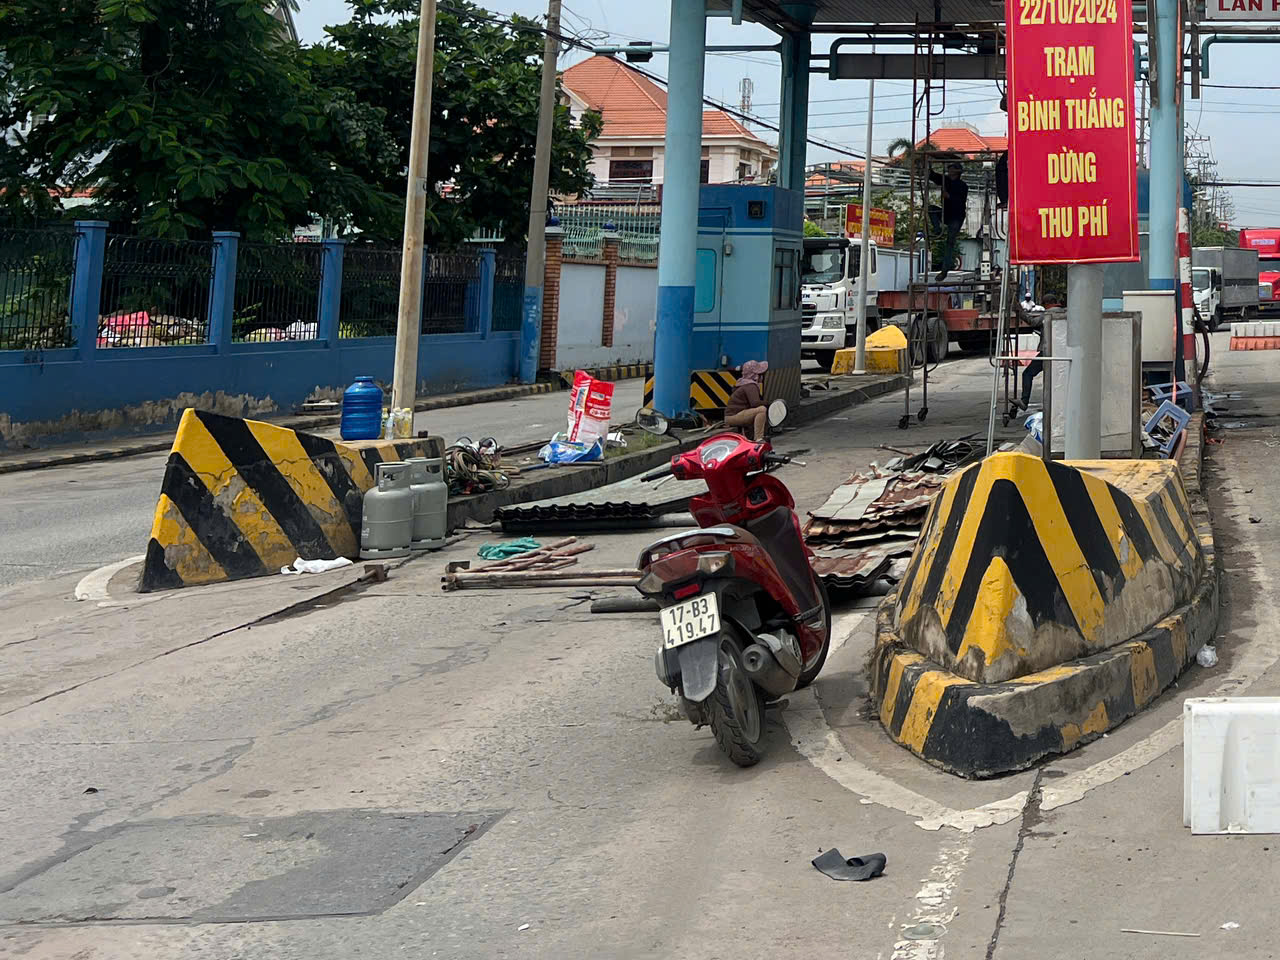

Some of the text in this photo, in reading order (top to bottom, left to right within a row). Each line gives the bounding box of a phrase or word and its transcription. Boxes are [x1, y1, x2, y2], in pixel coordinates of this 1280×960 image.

[1044, 46, 1095, 83] TRẠM
[1017, 87, 1124, 132] BÌNH THẮNG
[1047, 146, 1097, 184] DỪNG
[1038, 198, 1108, 238] THU PHÍ
[667, 614, 715, 645] 419.47
[669, 598, 708, 625] 17-B3
